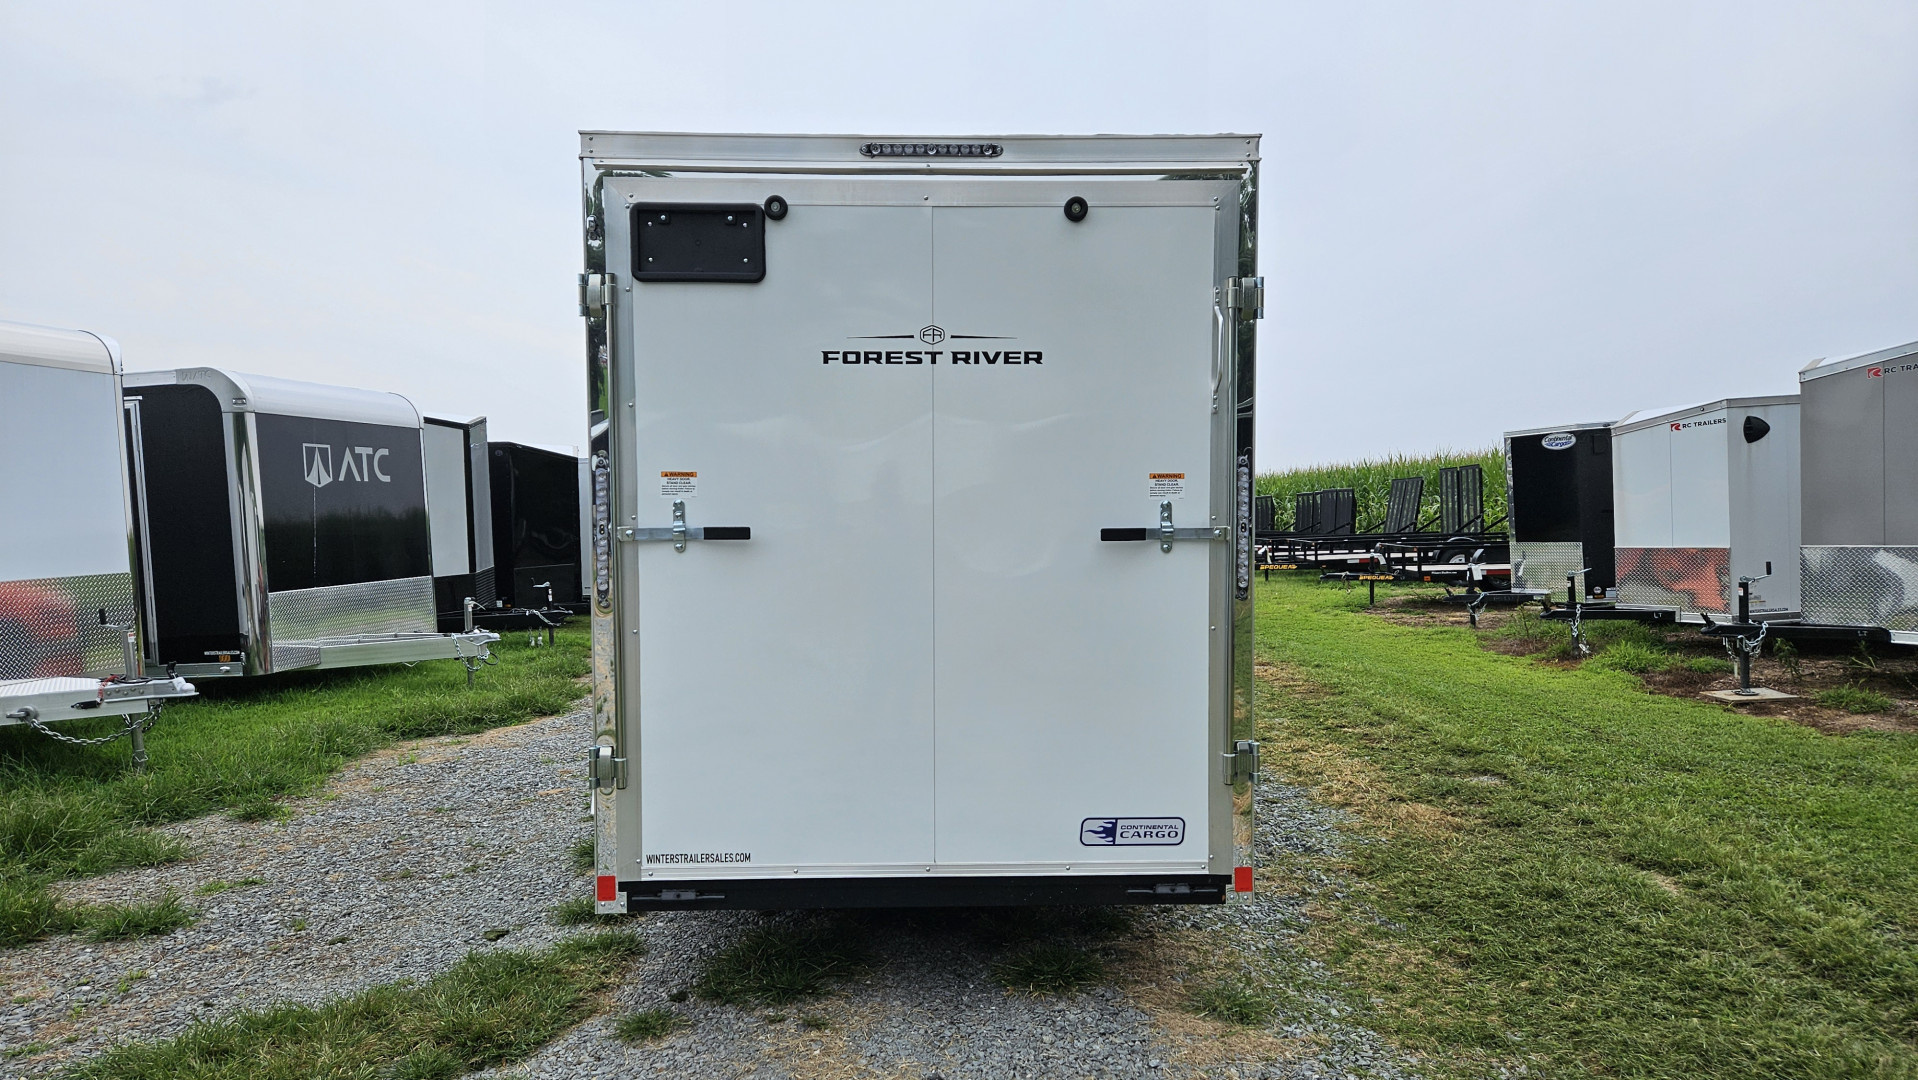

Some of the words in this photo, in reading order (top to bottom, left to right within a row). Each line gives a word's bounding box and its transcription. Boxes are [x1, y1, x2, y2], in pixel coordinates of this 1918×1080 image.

[821, 350, 943, 364] FOREST
[951, 350, 1043, 364] RIVER
[1694, 417, 1726, 428] TRAILERS
[338, 446, 390, 482] ATC
[1120, 830, 1179, 839] CARGO
[646, 852, 751, 864] WINTERSTRAILERSALES.COM
